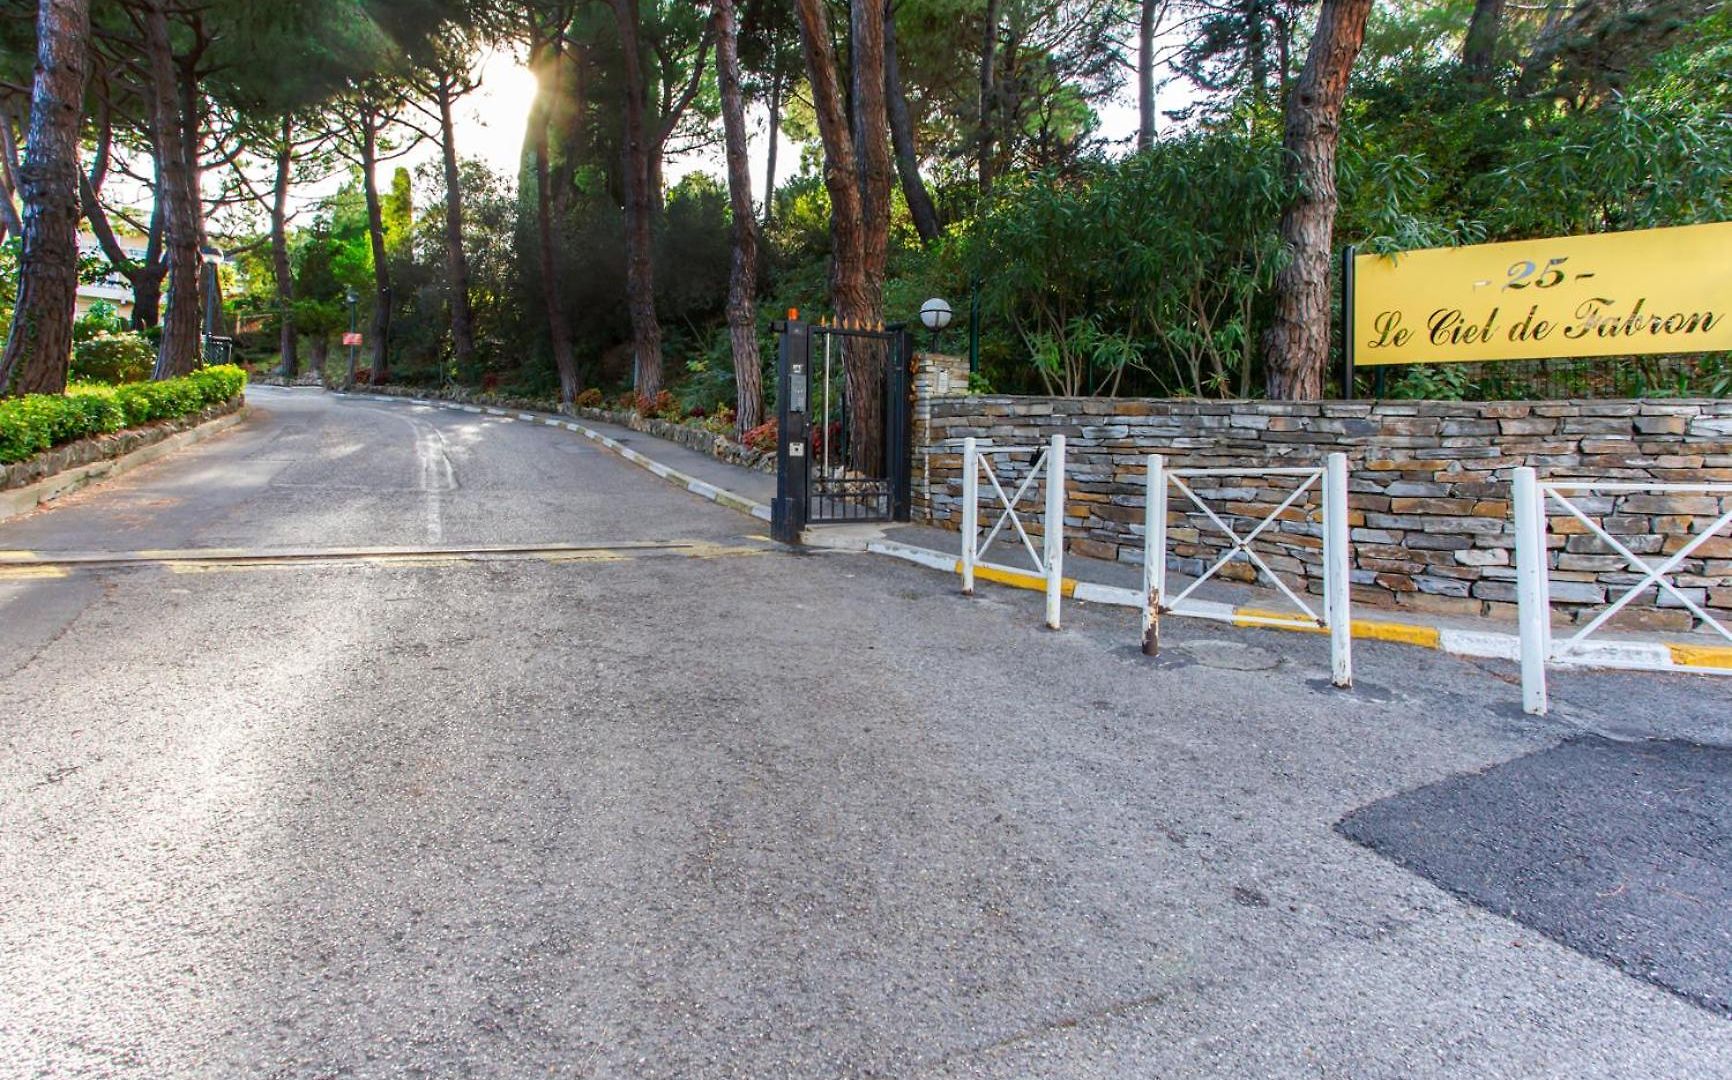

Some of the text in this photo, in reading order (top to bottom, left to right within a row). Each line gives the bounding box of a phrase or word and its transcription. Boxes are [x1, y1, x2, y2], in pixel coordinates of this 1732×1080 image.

[1367, 296, 1725, 349] Le Ciel de Fabron
